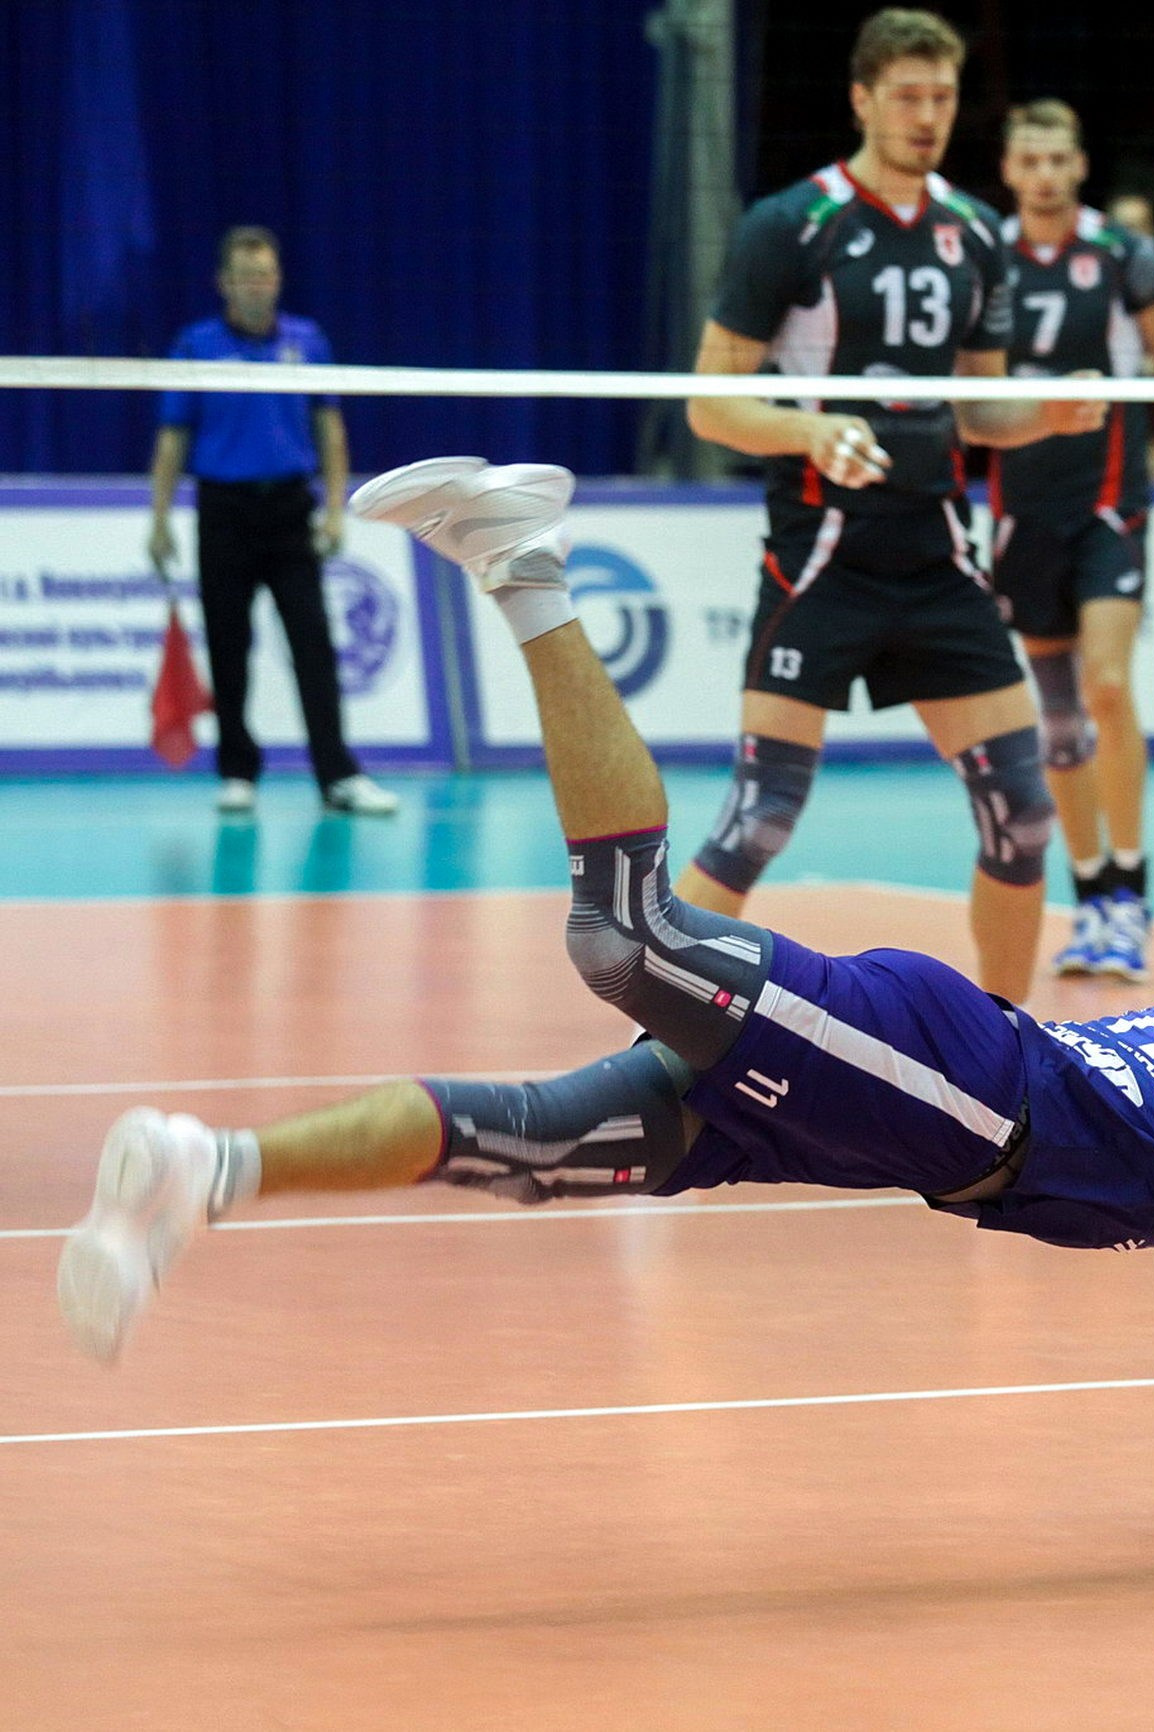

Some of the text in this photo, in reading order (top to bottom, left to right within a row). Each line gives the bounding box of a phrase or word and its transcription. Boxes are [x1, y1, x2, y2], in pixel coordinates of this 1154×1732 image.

[872, 265, 951, 347] 13
[1023, 291, 1068, 355] 7
[769, 645, 802, 681] 13
[734, 1068, 790, 1109] 11
